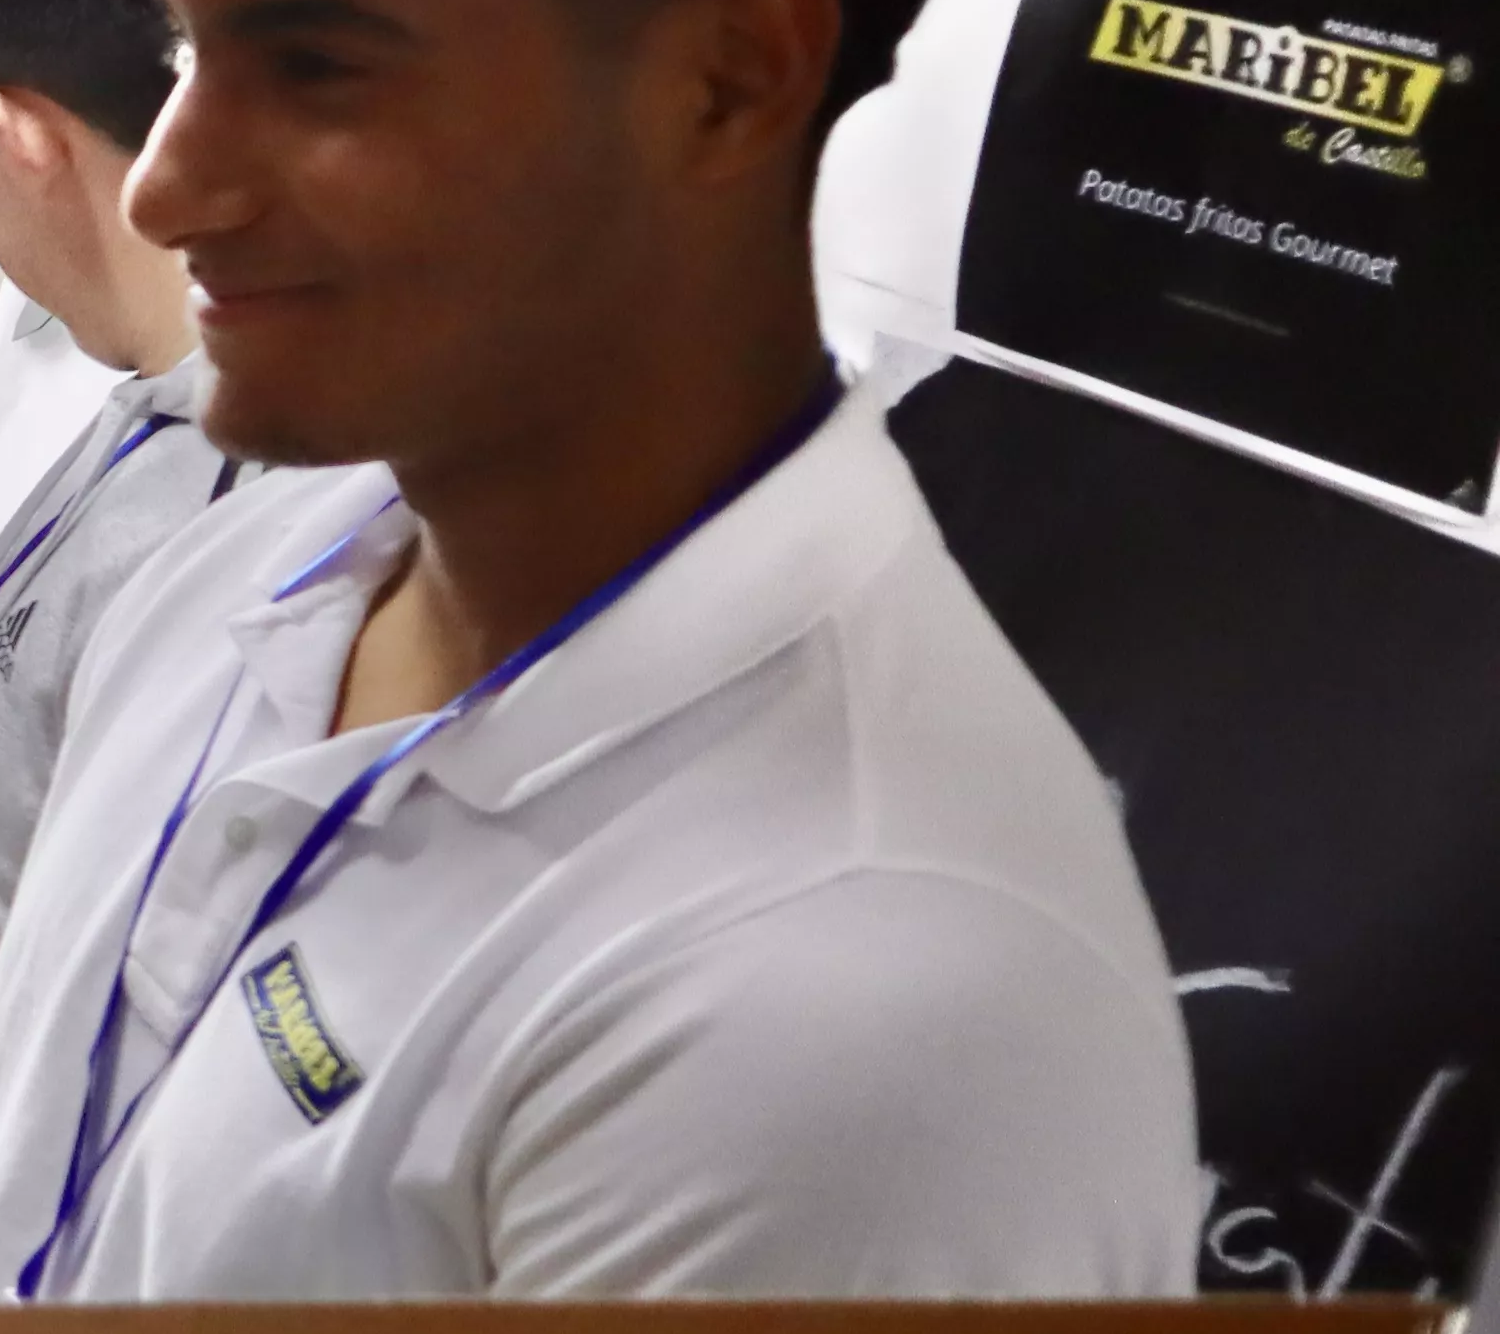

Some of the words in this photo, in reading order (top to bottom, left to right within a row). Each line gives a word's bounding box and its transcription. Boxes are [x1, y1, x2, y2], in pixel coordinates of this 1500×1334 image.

[1079, 168, 1185, 222] Patatas
[1185, 197, 1263, 244] fritas
[1270, 221, 1399, 286] Gourmet
